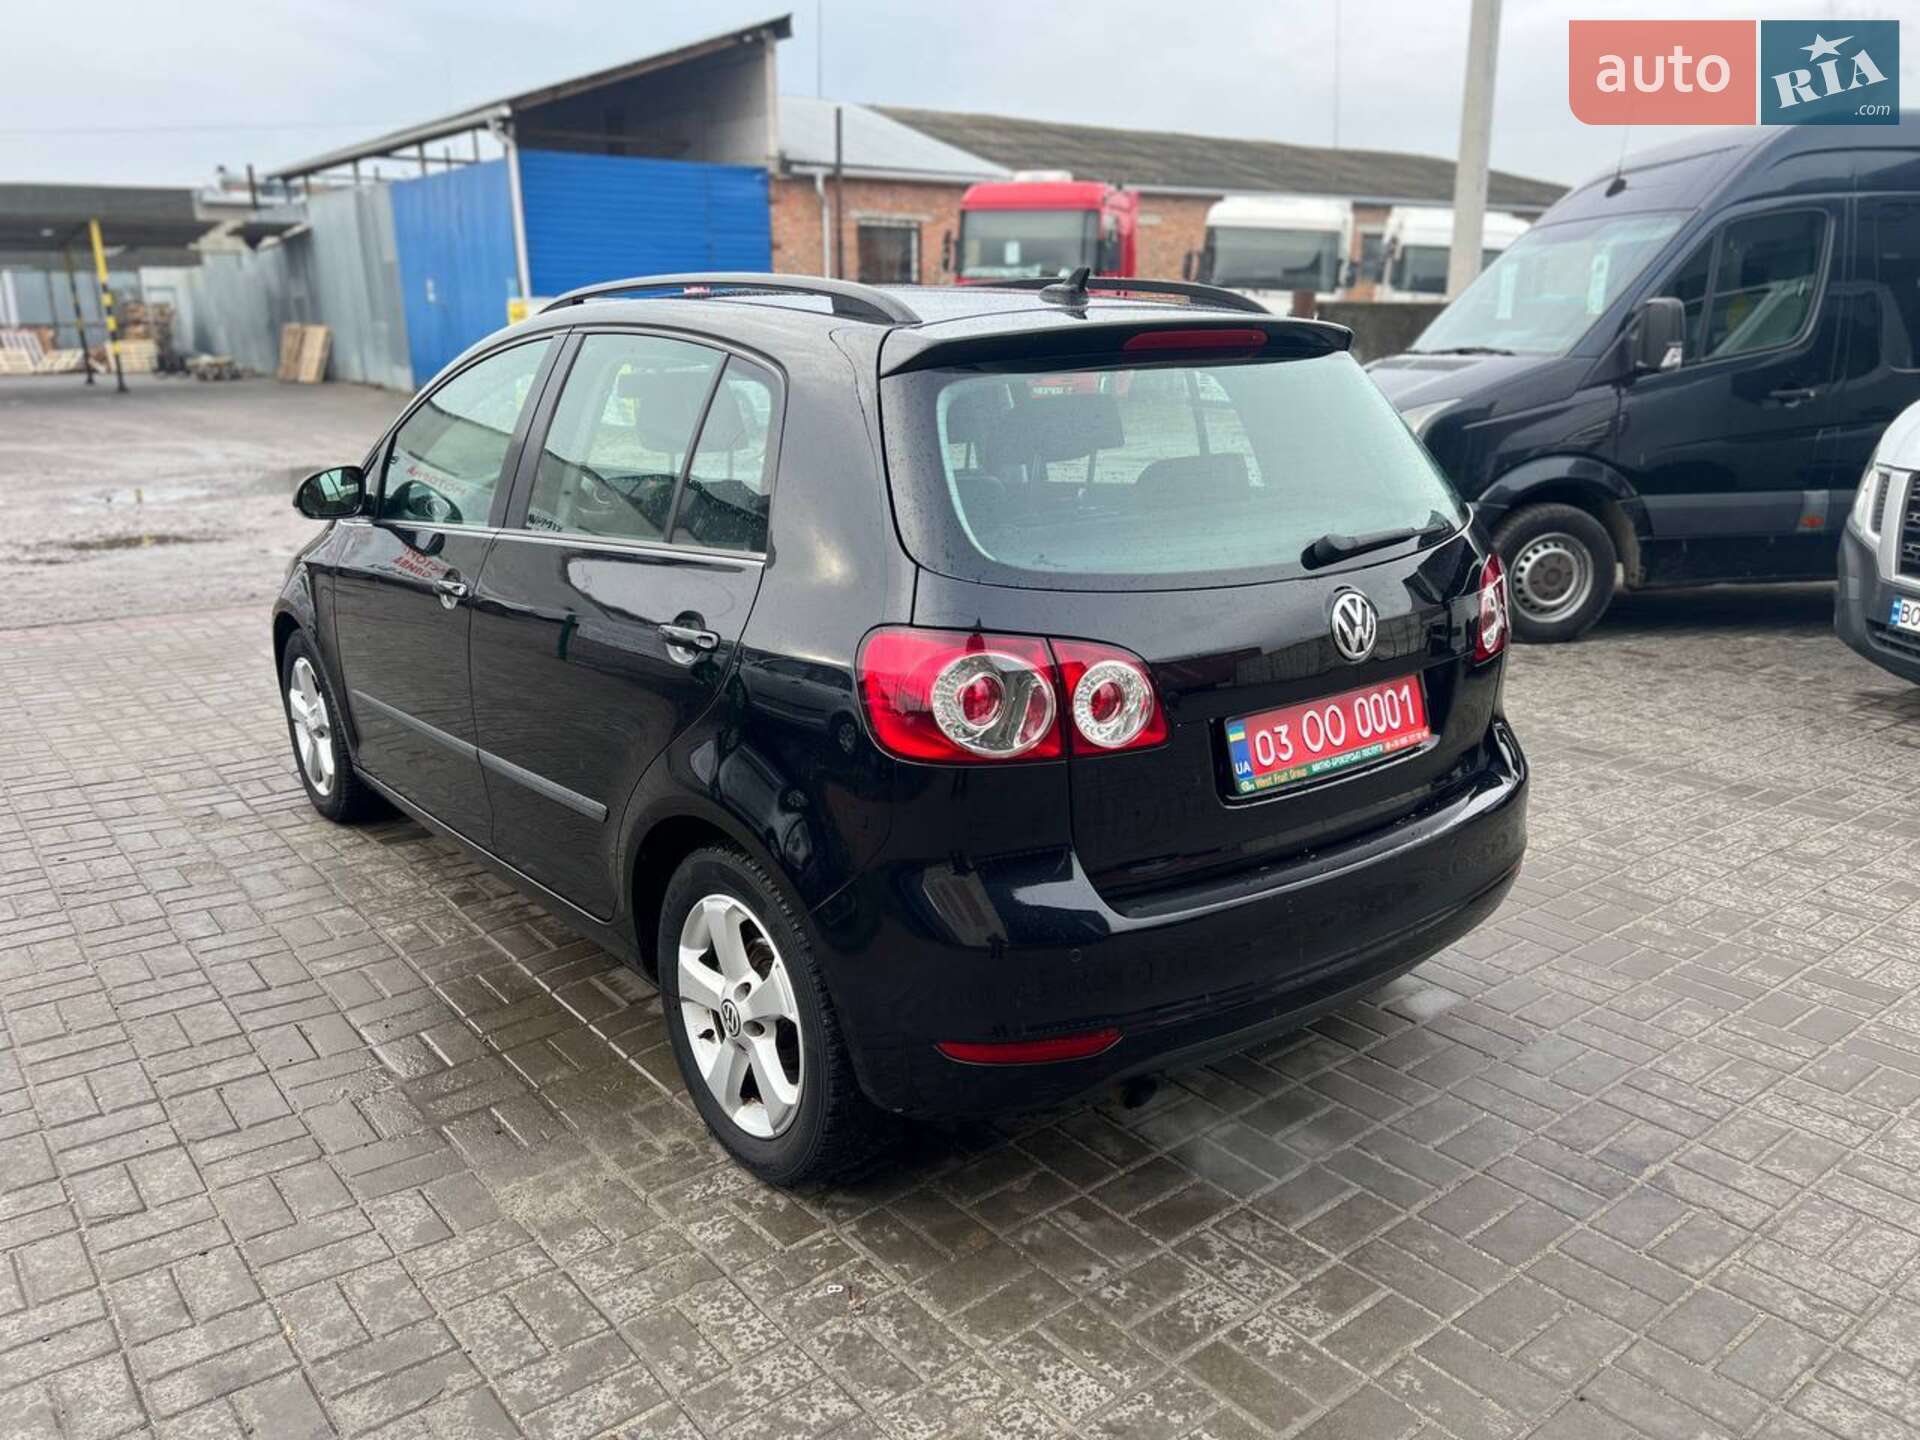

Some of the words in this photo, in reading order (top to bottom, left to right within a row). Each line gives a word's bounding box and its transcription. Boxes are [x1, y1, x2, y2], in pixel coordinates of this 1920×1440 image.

[1254, 724, 1294, 767] 03
[1353, 684, 1416, 738] 0001
[1235, 760, 1251, 775] UA
